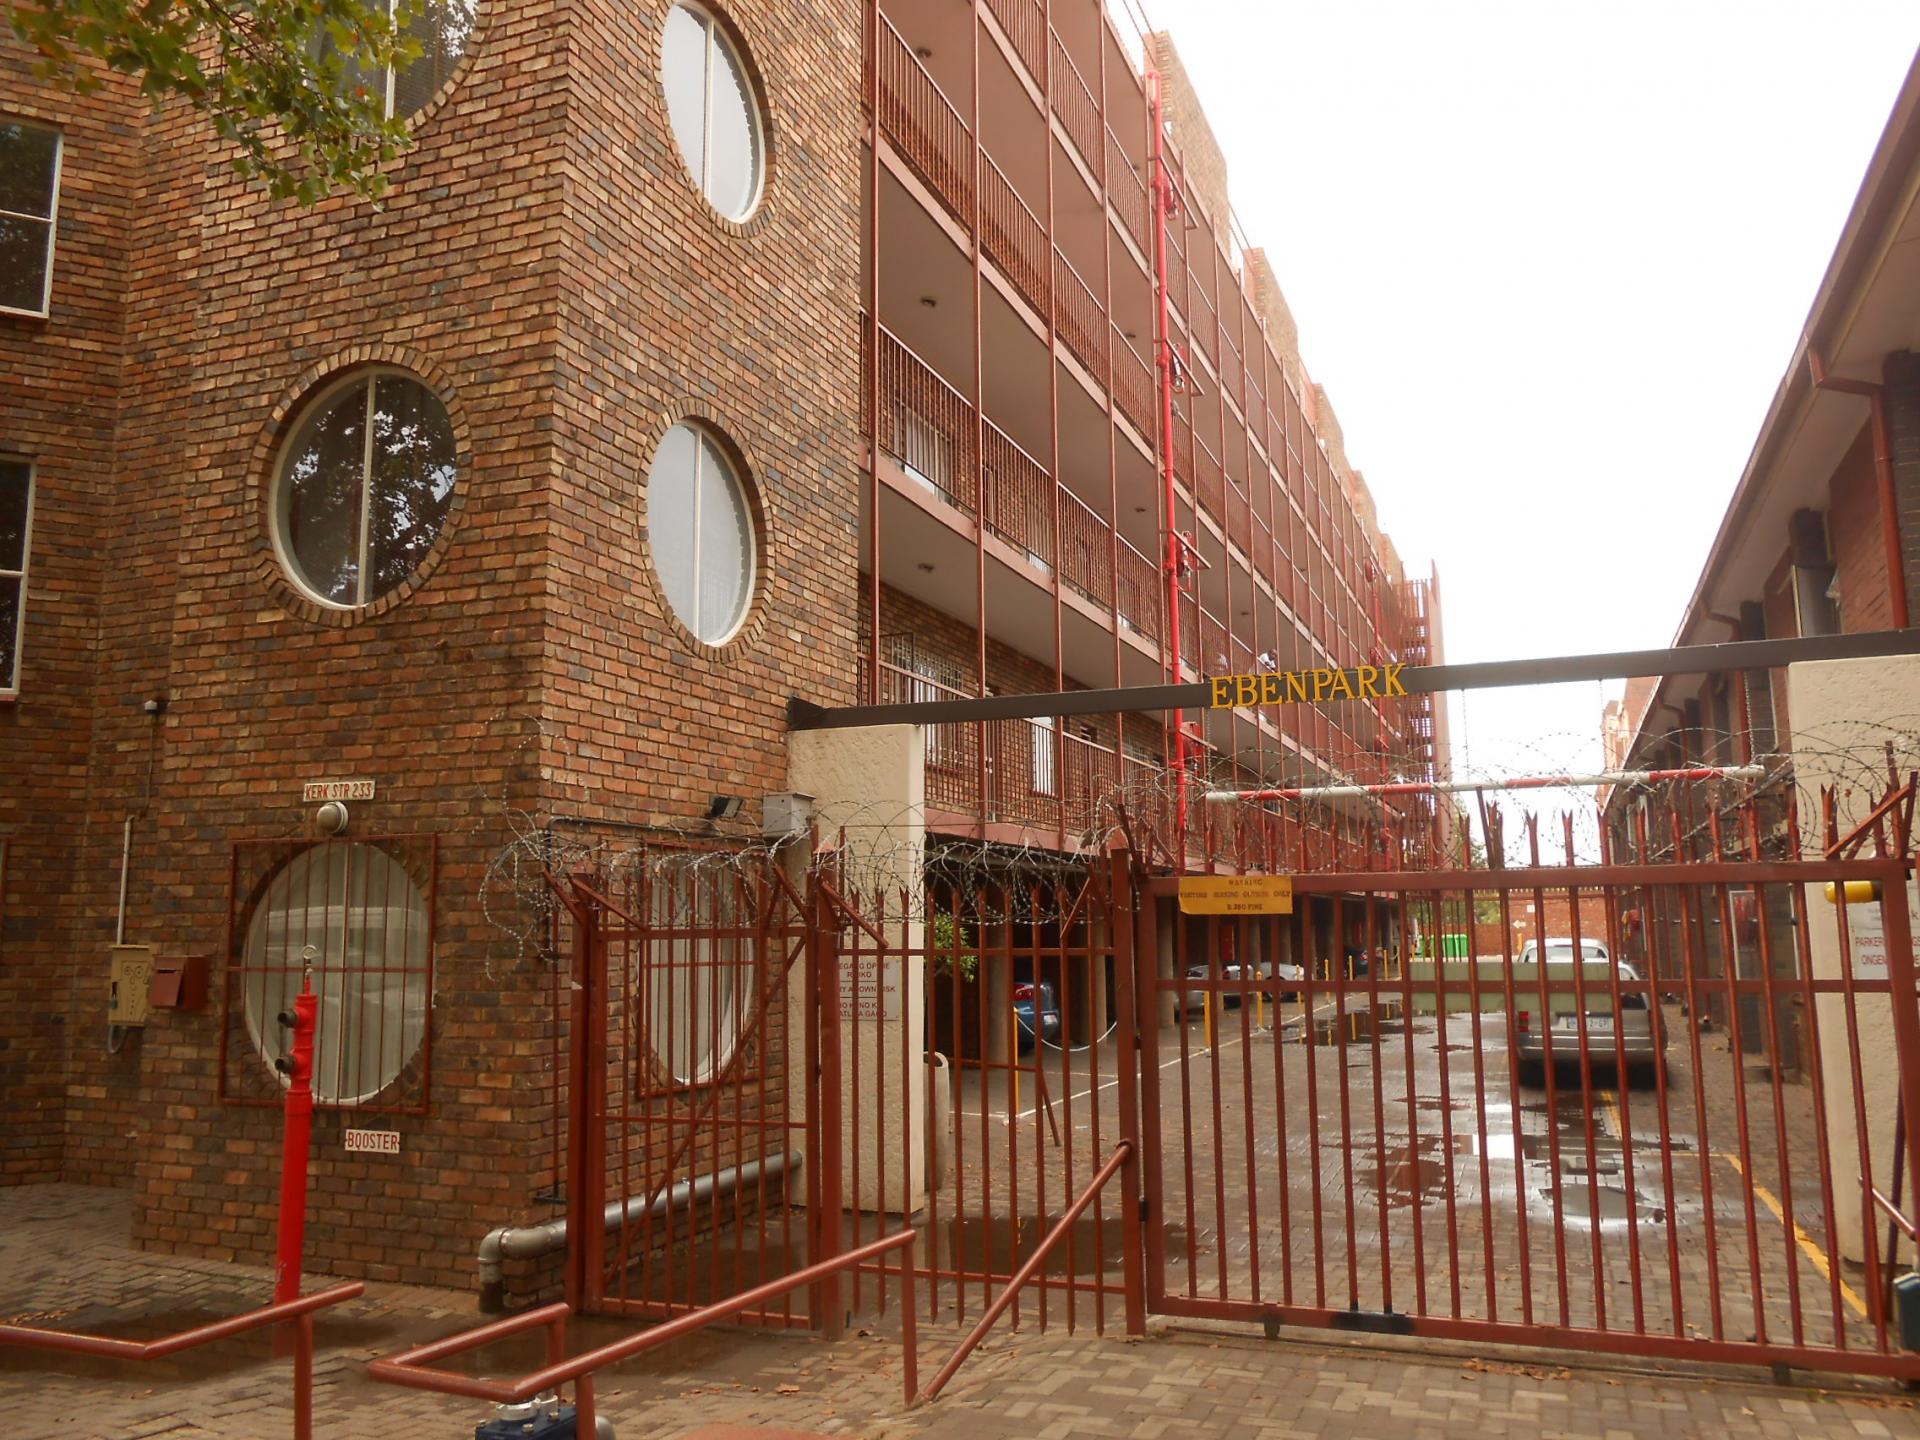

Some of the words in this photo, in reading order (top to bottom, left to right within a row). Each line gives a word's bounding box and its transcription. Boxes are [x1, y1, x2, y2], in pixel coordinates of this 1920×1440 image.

[1210, 662, 1408, 710] EBENPARK
[304, 784, 329, 800] KERK
[332, 783, 350, 798] STR
[352, 782, 372, 797] 233
[1247, 903, 1263, 911] FINE
[347, 1131, 398, 1150] BOOSTER
